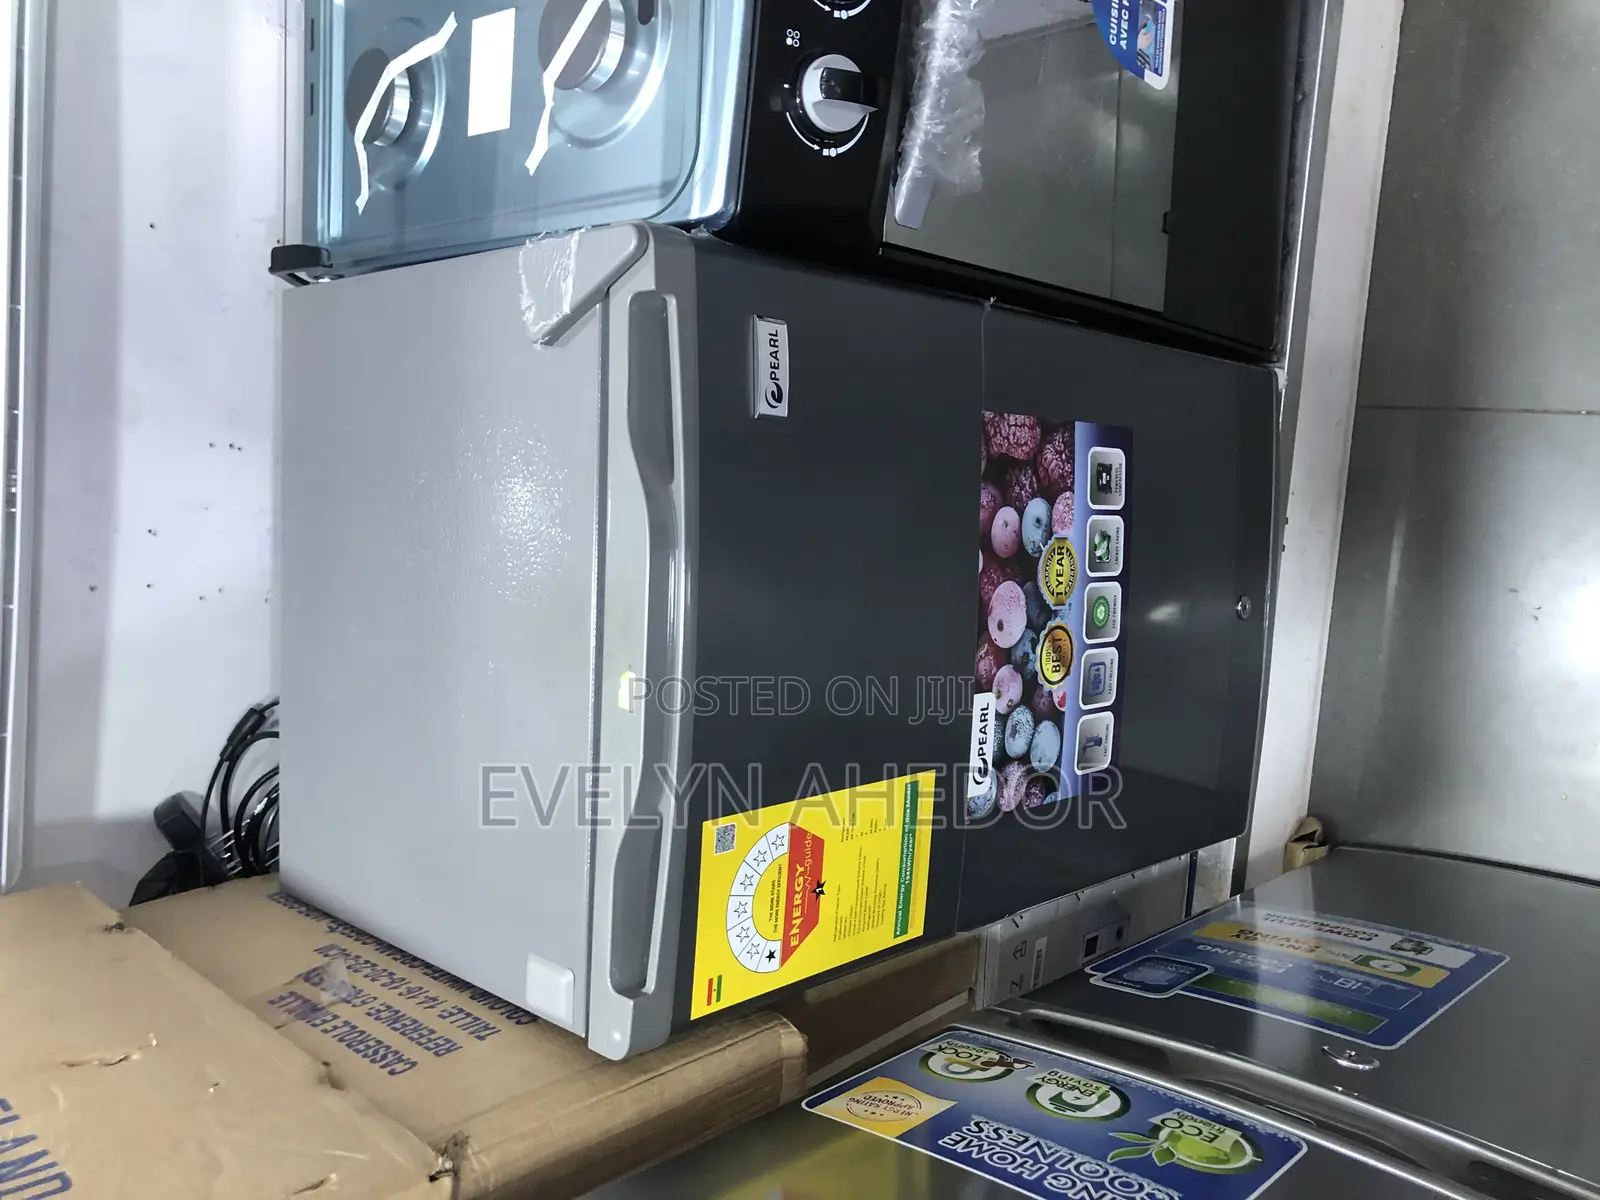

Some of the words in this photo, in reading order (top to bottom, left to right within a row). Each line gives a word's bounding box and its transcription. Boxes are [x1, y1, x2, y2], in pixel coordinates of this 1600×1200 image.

[1109, 0, 1119, 45] CUISI
[1119, 8, 1129, 50] AVEC
[768, 329, 780, 382] PEARL
[1055, 545, 1064, 590] YEAR
[1051, 636, 1063, 673] BEST
[977, 702, 989, 758] PEARL
[803, 832, 813, 867] guide
[789, 863, 805, 947] ENERGY
[897, 884, 906, 909] Energy
[320, 1020, 418, 1076] CASSEROLE
[931, 1044, 980, 1062] LOCK
[1035, 1076, 1096, 1098] ENERGY
[1160, 1117, 1220, 1143] ECO
[1172, 1111, 1227, 1134] friendly
[938, 1131, 1049, 1180] HOME
